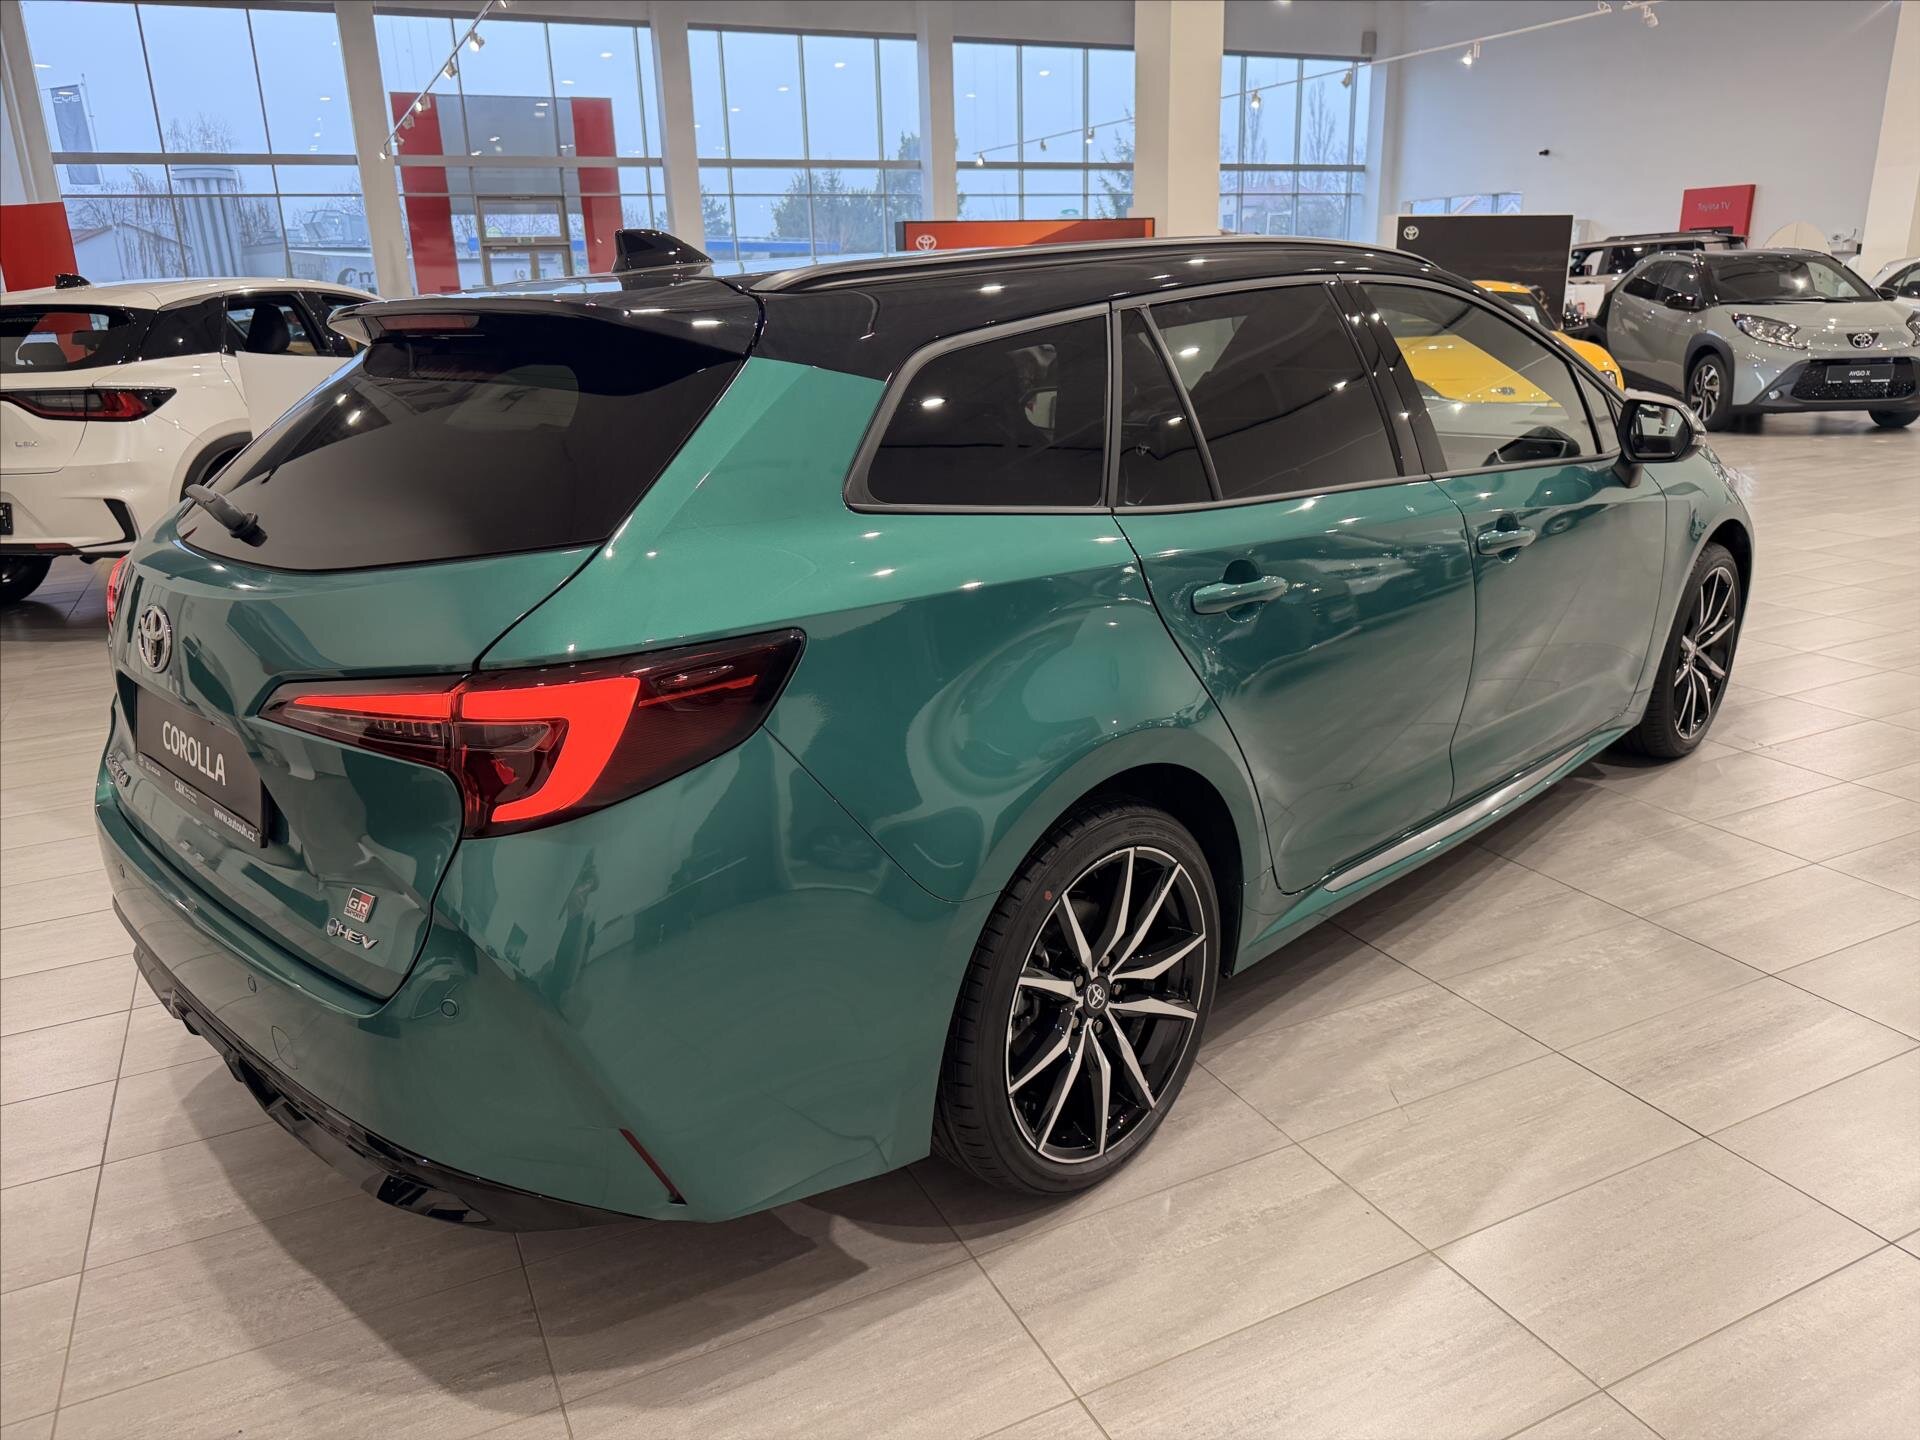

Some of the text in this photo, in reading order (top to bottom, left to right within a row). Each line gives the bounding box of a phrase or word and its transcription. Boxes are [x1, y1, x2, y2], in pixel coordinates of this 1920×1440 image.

[162, 720, 226, 787] COROLLA
[349, 898, 368, 914] GR
[337, 923, 378, 949] HEV
